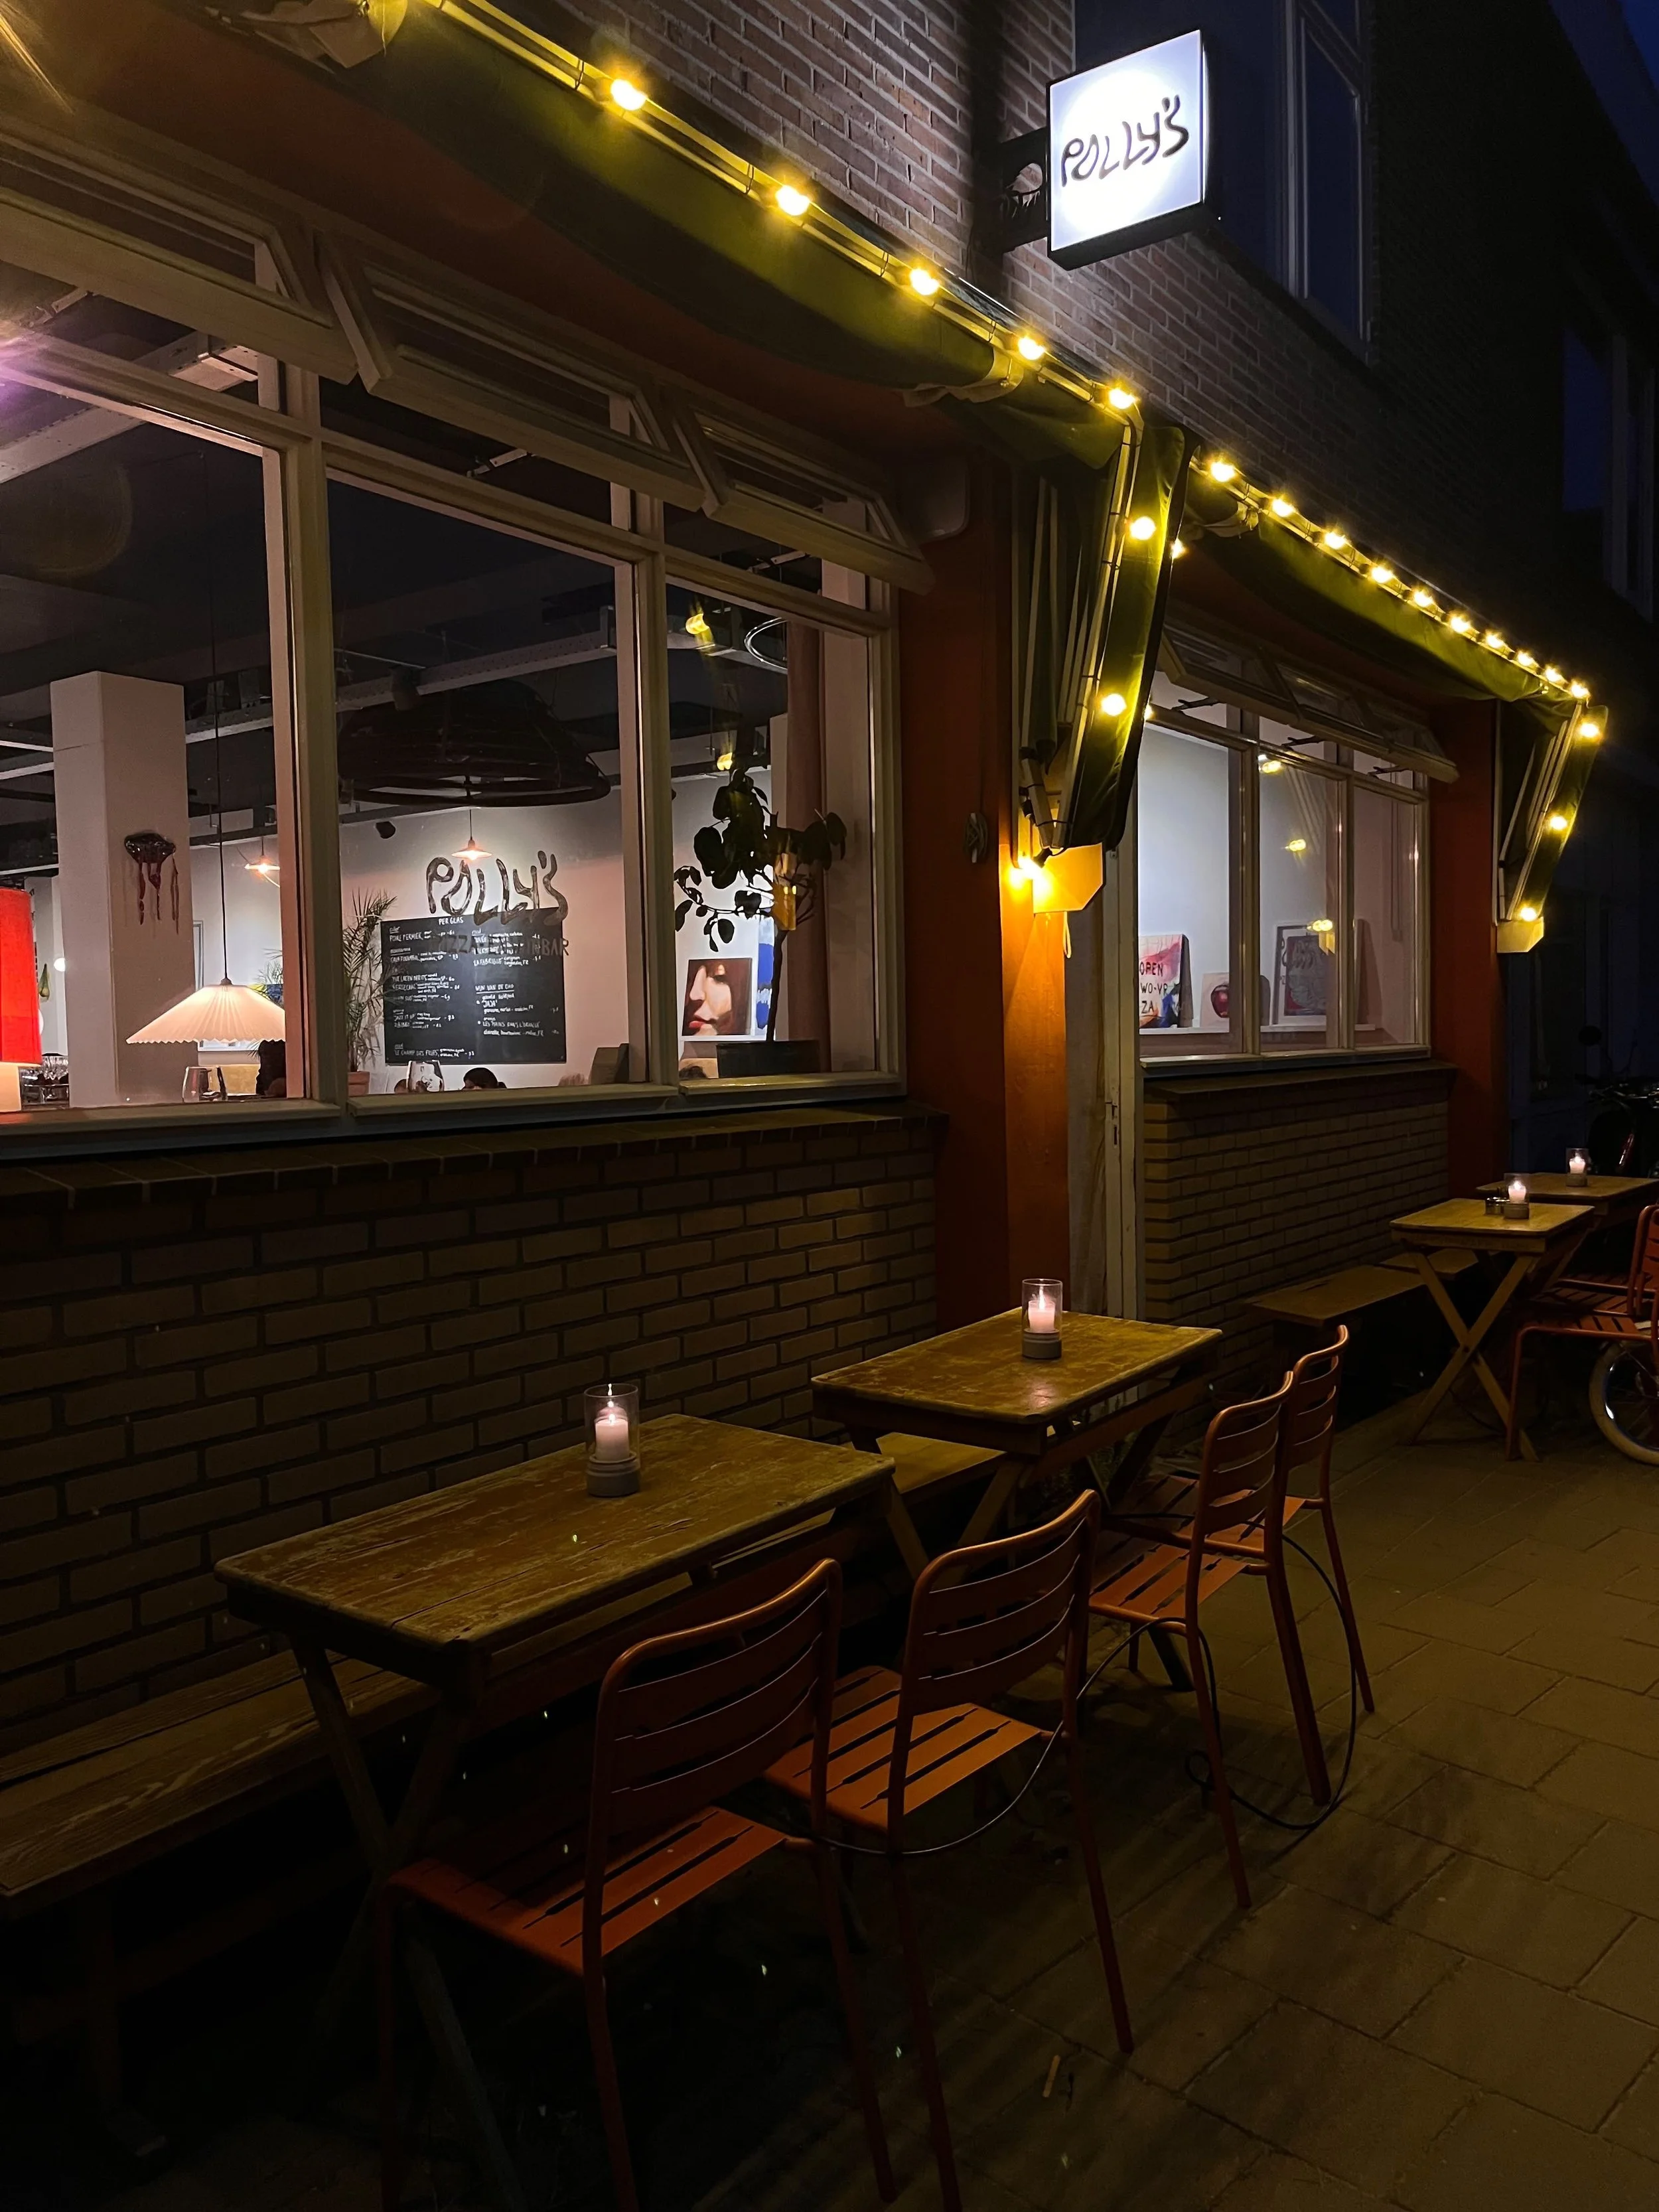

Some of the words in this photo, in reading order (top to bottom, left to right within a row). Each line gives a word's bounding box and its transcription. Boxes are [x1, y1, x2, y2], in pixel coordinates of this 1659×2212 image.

[1061, 95, 1189, 187] POLLY'S
[426, 850, 568, 926] POLLY'S
[1139, 962, 1163, 976] OPEN
[1141, 1000, 1155, 1014] ZA
